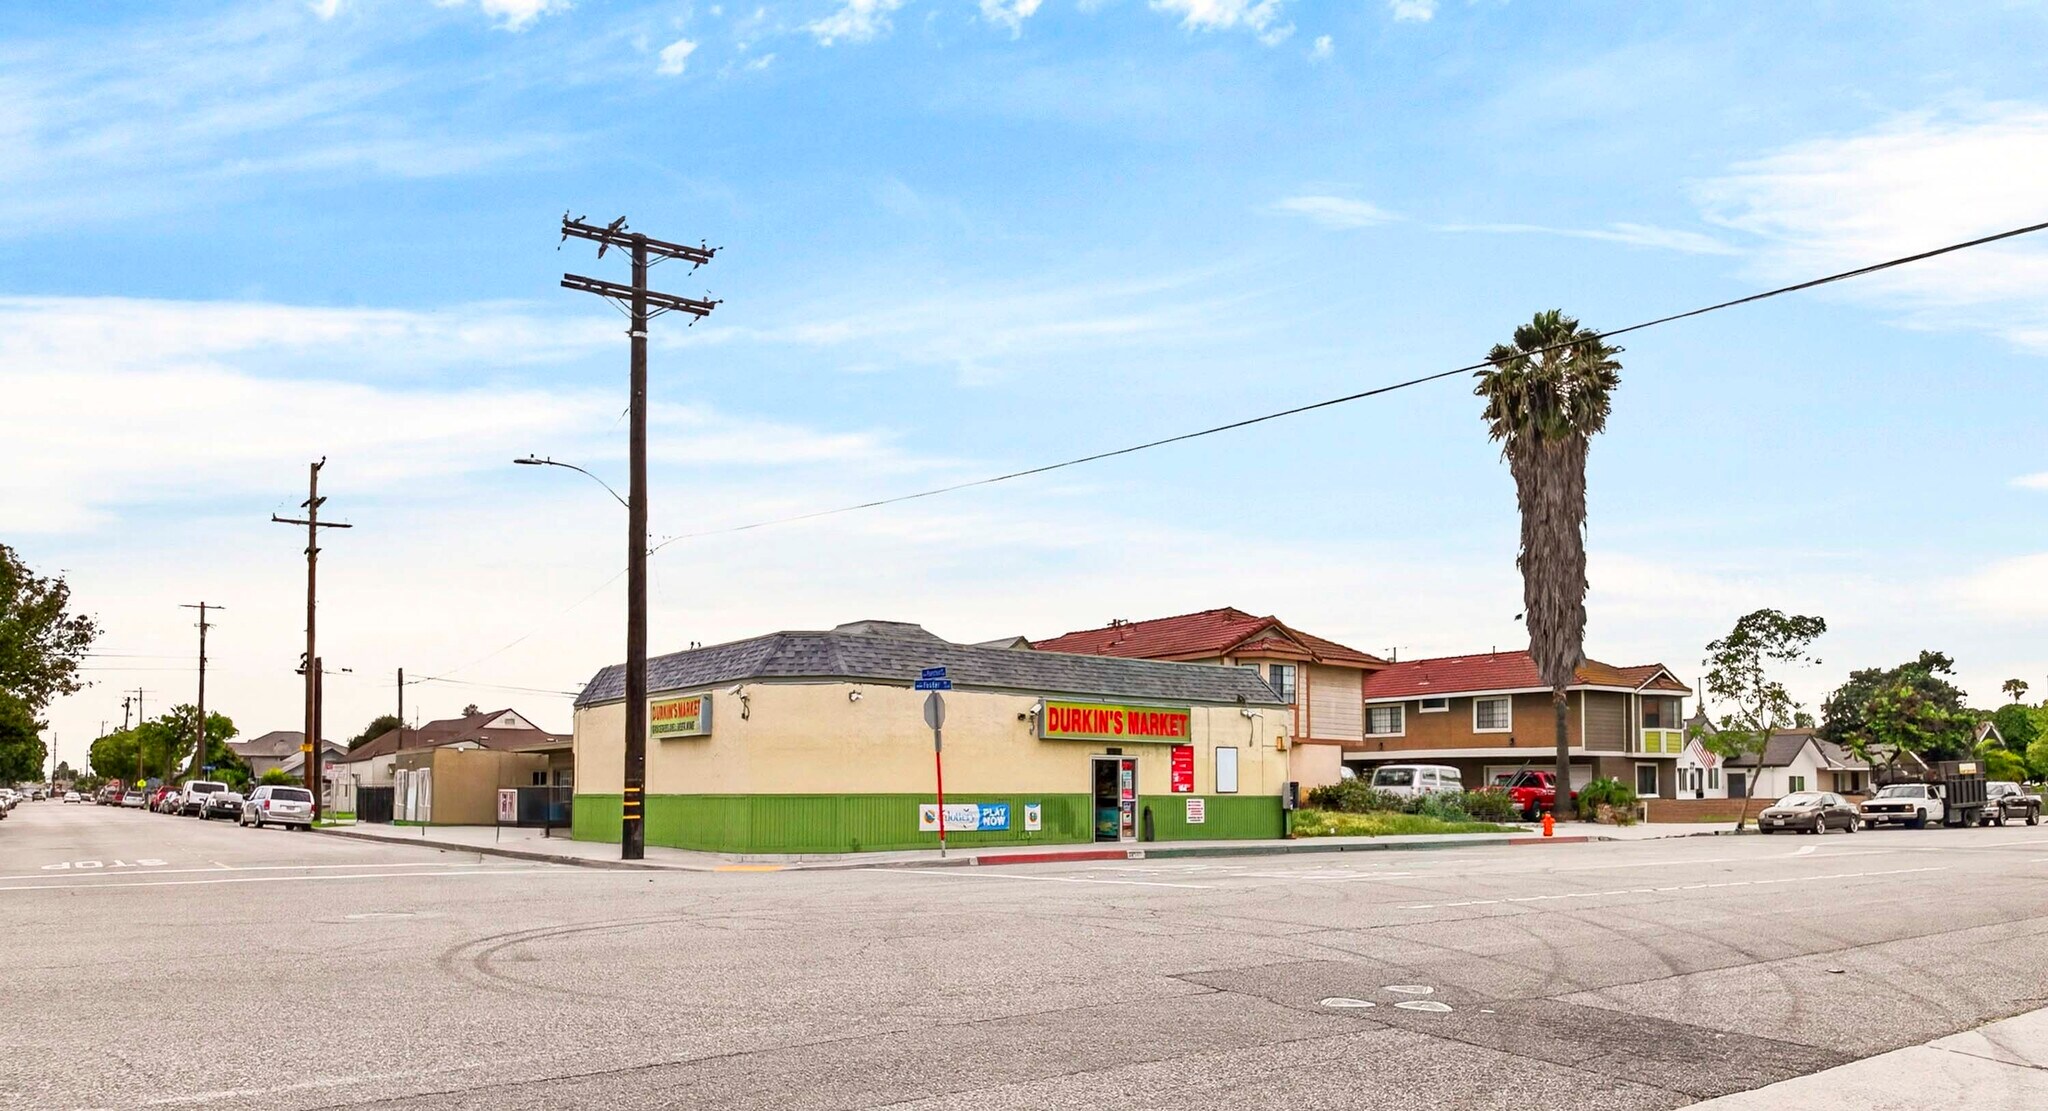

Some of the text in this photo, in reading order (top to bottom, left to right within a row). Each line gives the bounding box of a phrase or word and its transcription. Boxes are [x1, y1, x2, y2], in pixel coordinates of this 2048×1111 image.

[652, 699, 701, 721] DURKIN'S MARKET
[1048, 707, 1188, 737] DURKIN'S MARKET
[982, 807, 1006, 817] PLAY
[982, 816, 1006, 826] NOW
[41, 859, 168, 870] STOP
